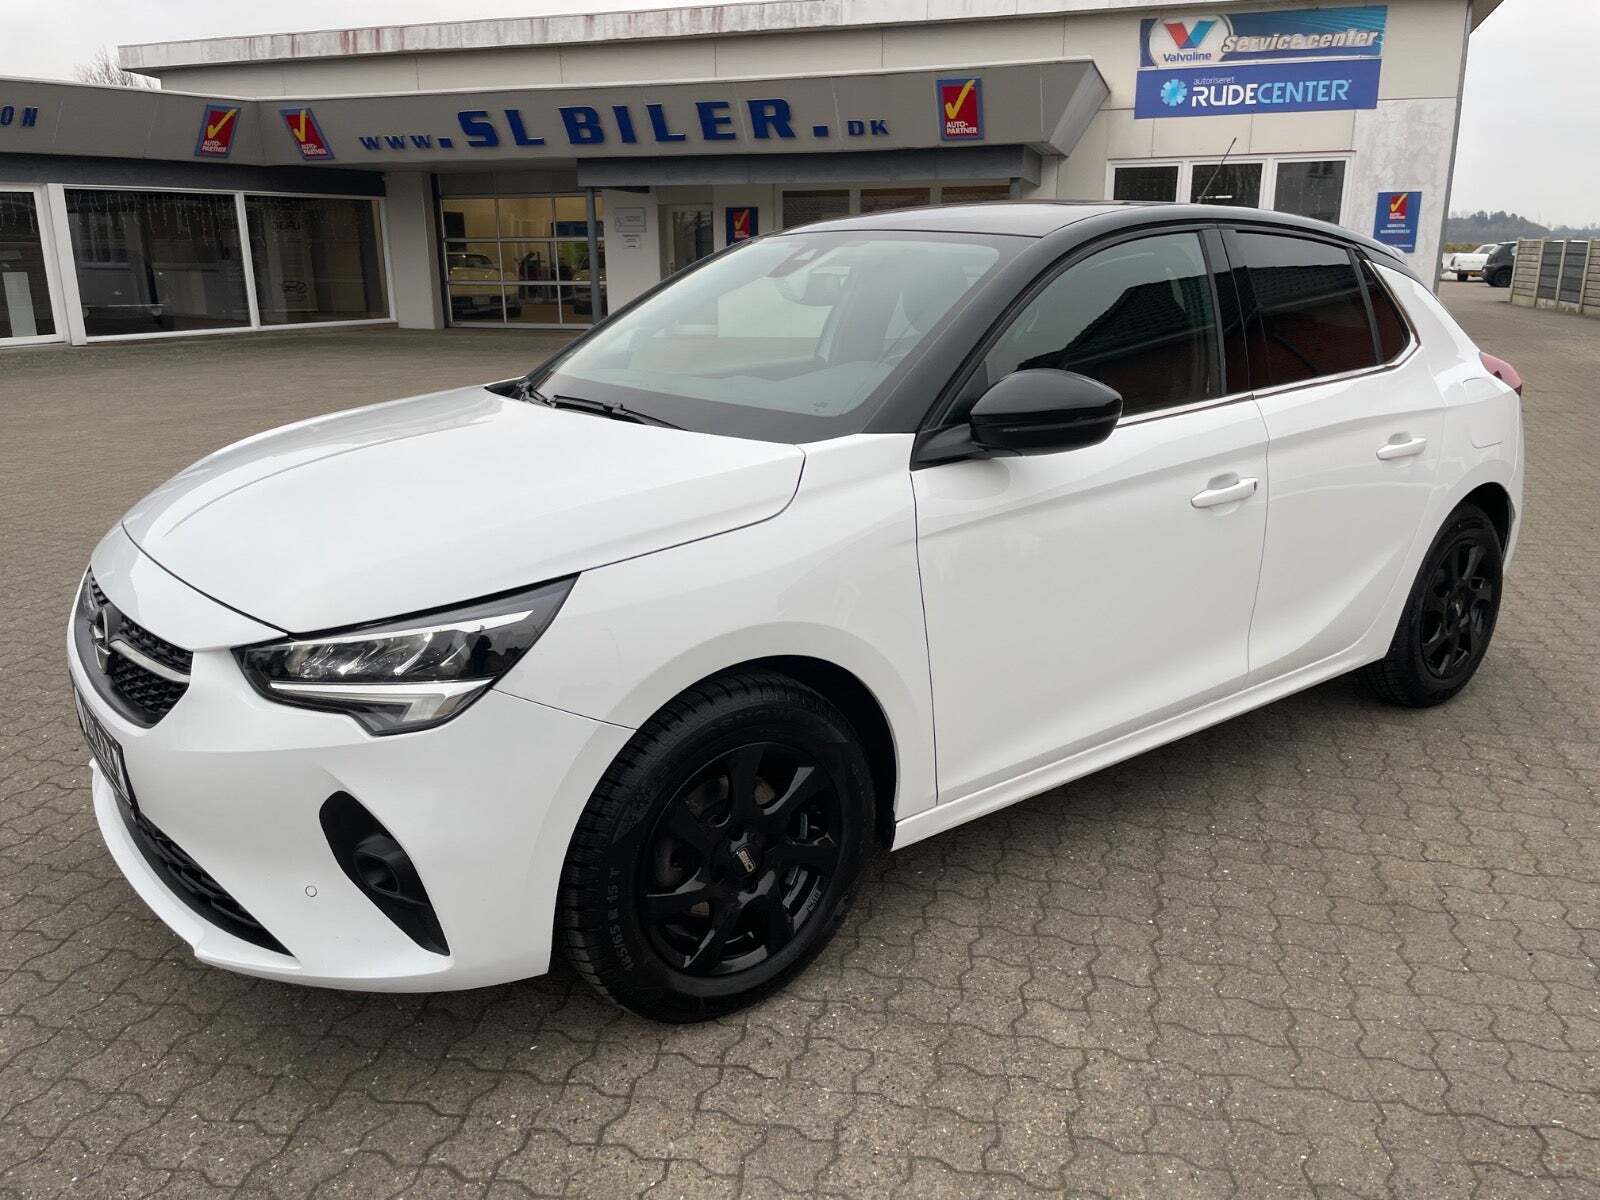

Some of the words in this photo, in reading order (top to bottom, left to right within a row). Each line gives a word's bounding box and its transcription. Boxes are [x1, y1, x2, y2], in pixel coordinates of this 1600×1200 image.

[1307, 28, 1379, 50] center
[1163, 51, 1212, 62] Valvoline
[1191, 80, 1349, 108] RUDECENTER
[946, 127, 977, 135] PARTNER
